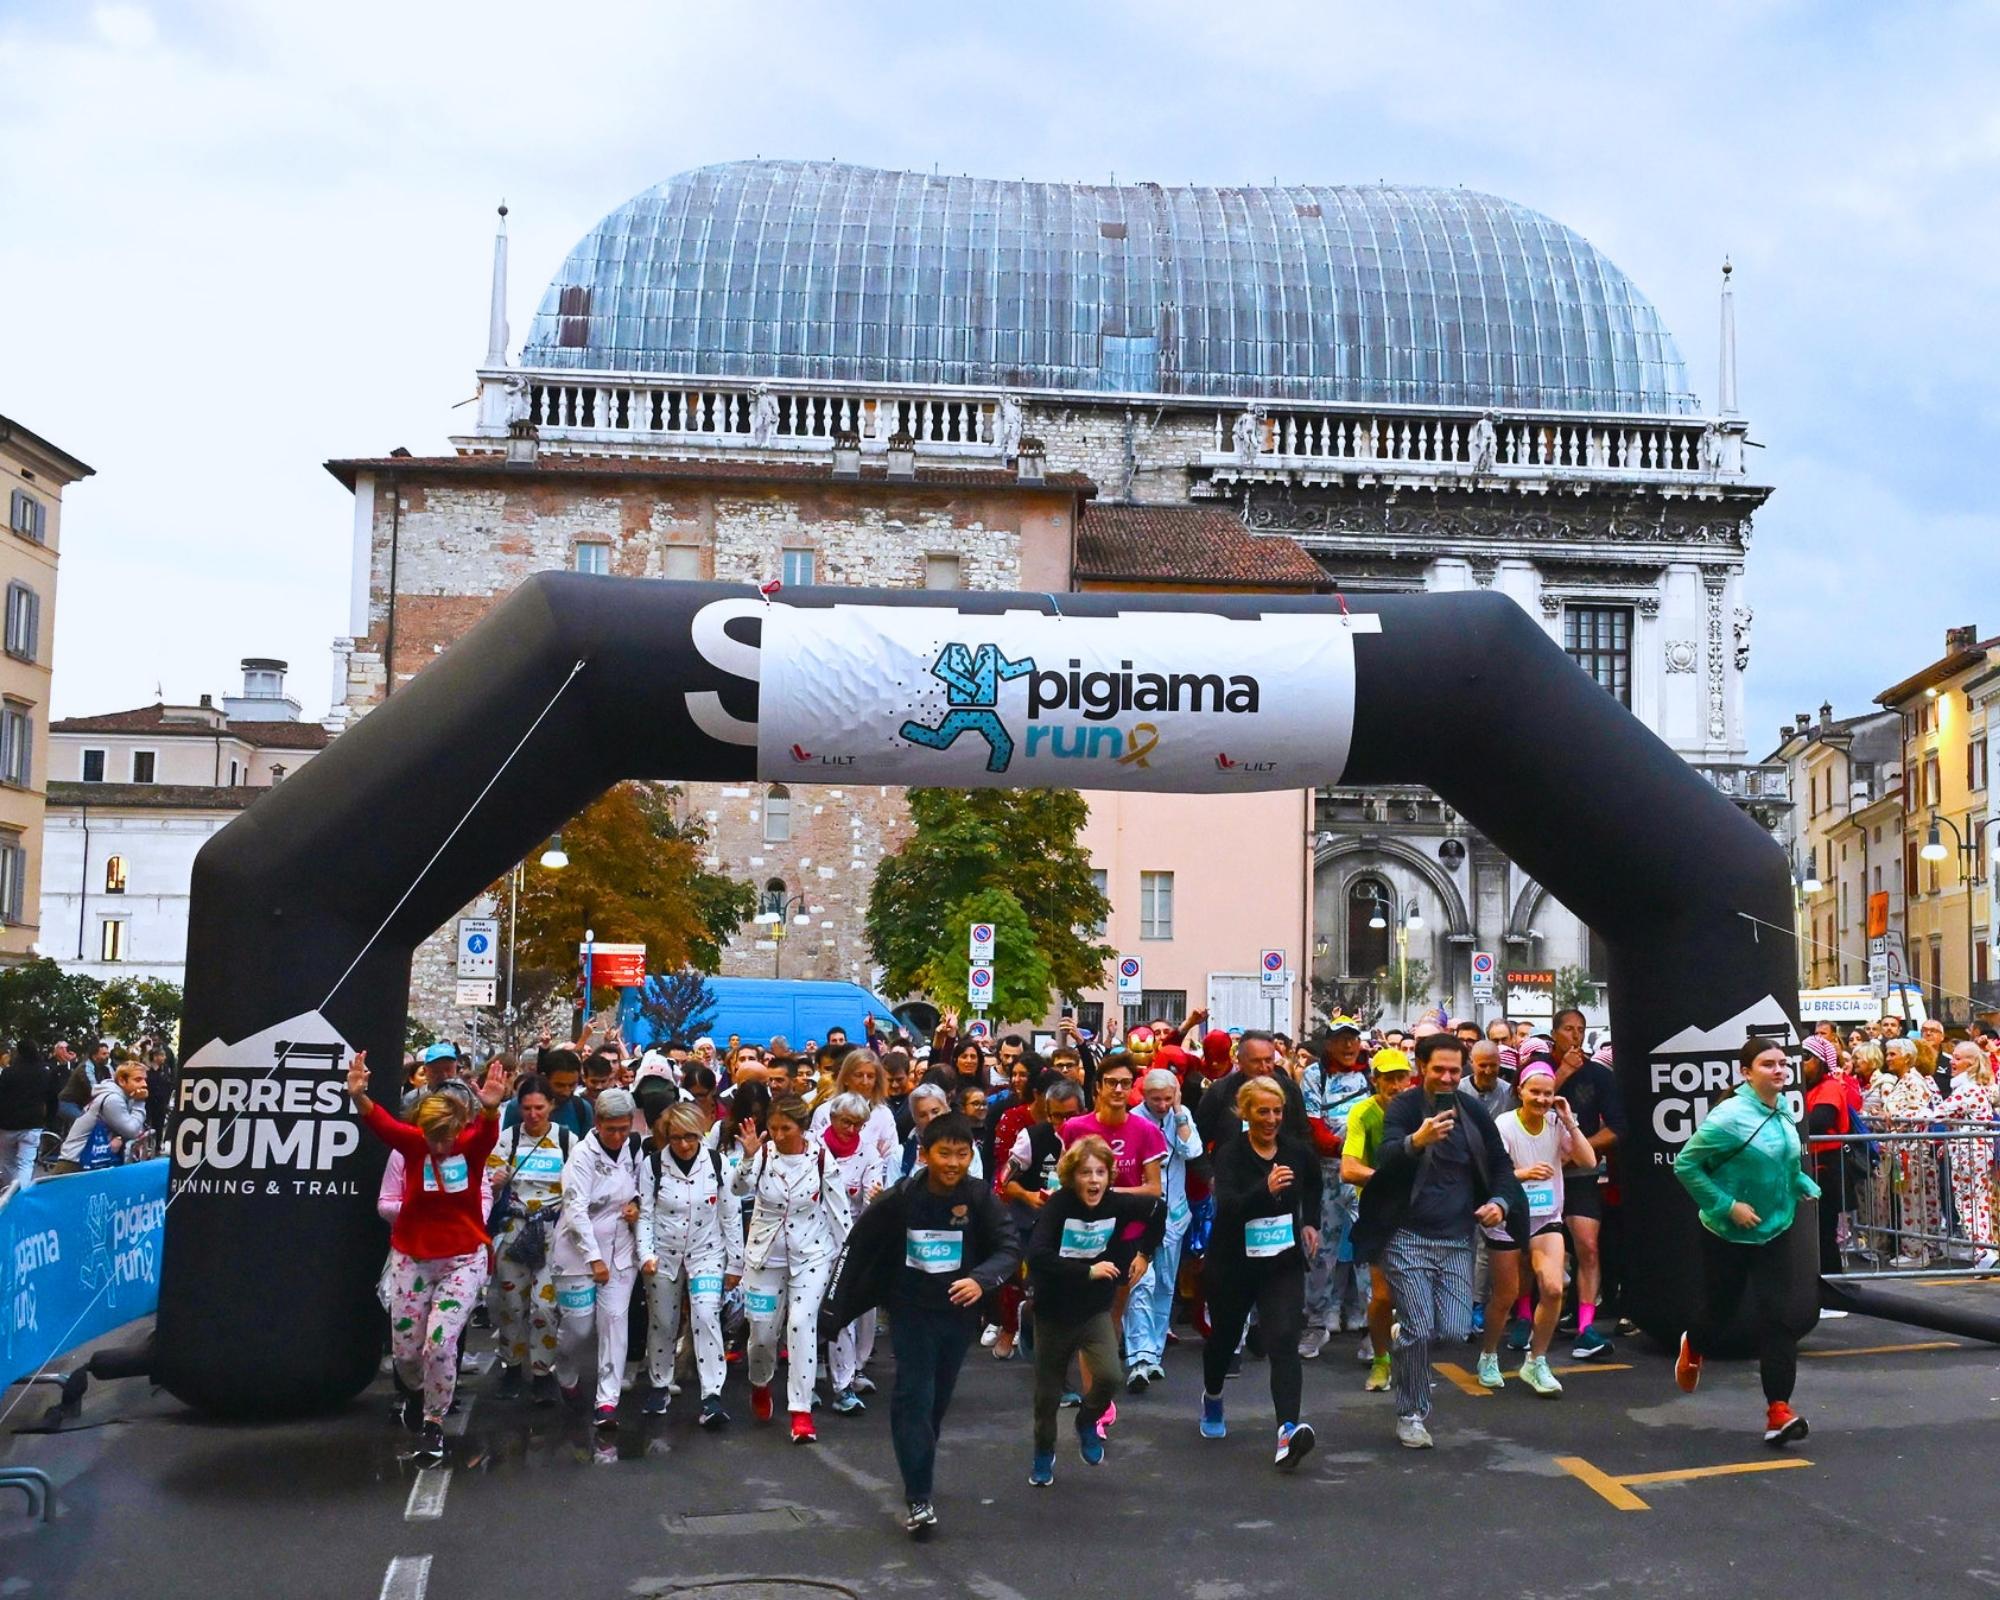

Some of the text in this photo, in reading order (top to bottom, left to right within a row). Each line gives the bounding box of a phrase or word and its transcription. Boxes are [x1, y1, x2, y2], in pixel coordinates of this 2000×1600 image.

[1027, 658, 1260, 721] pigiama
[1025, 724, 1124, 759] run
[822, 755, 857, 766] LILT
[1244, 762, 1278, 772] LILT
[1507, 974, 1553, 983] CREPAX
[1814, 1001, 1860, 1011] BRESCIA
[175, 1117, 360, 1170] GUMP
[171, 1179, 359, 1195] RUNNING & TRAIL
[1254, 1229, 1287, 1243] 7947
[913, 1244, 951, 1258] 7649
